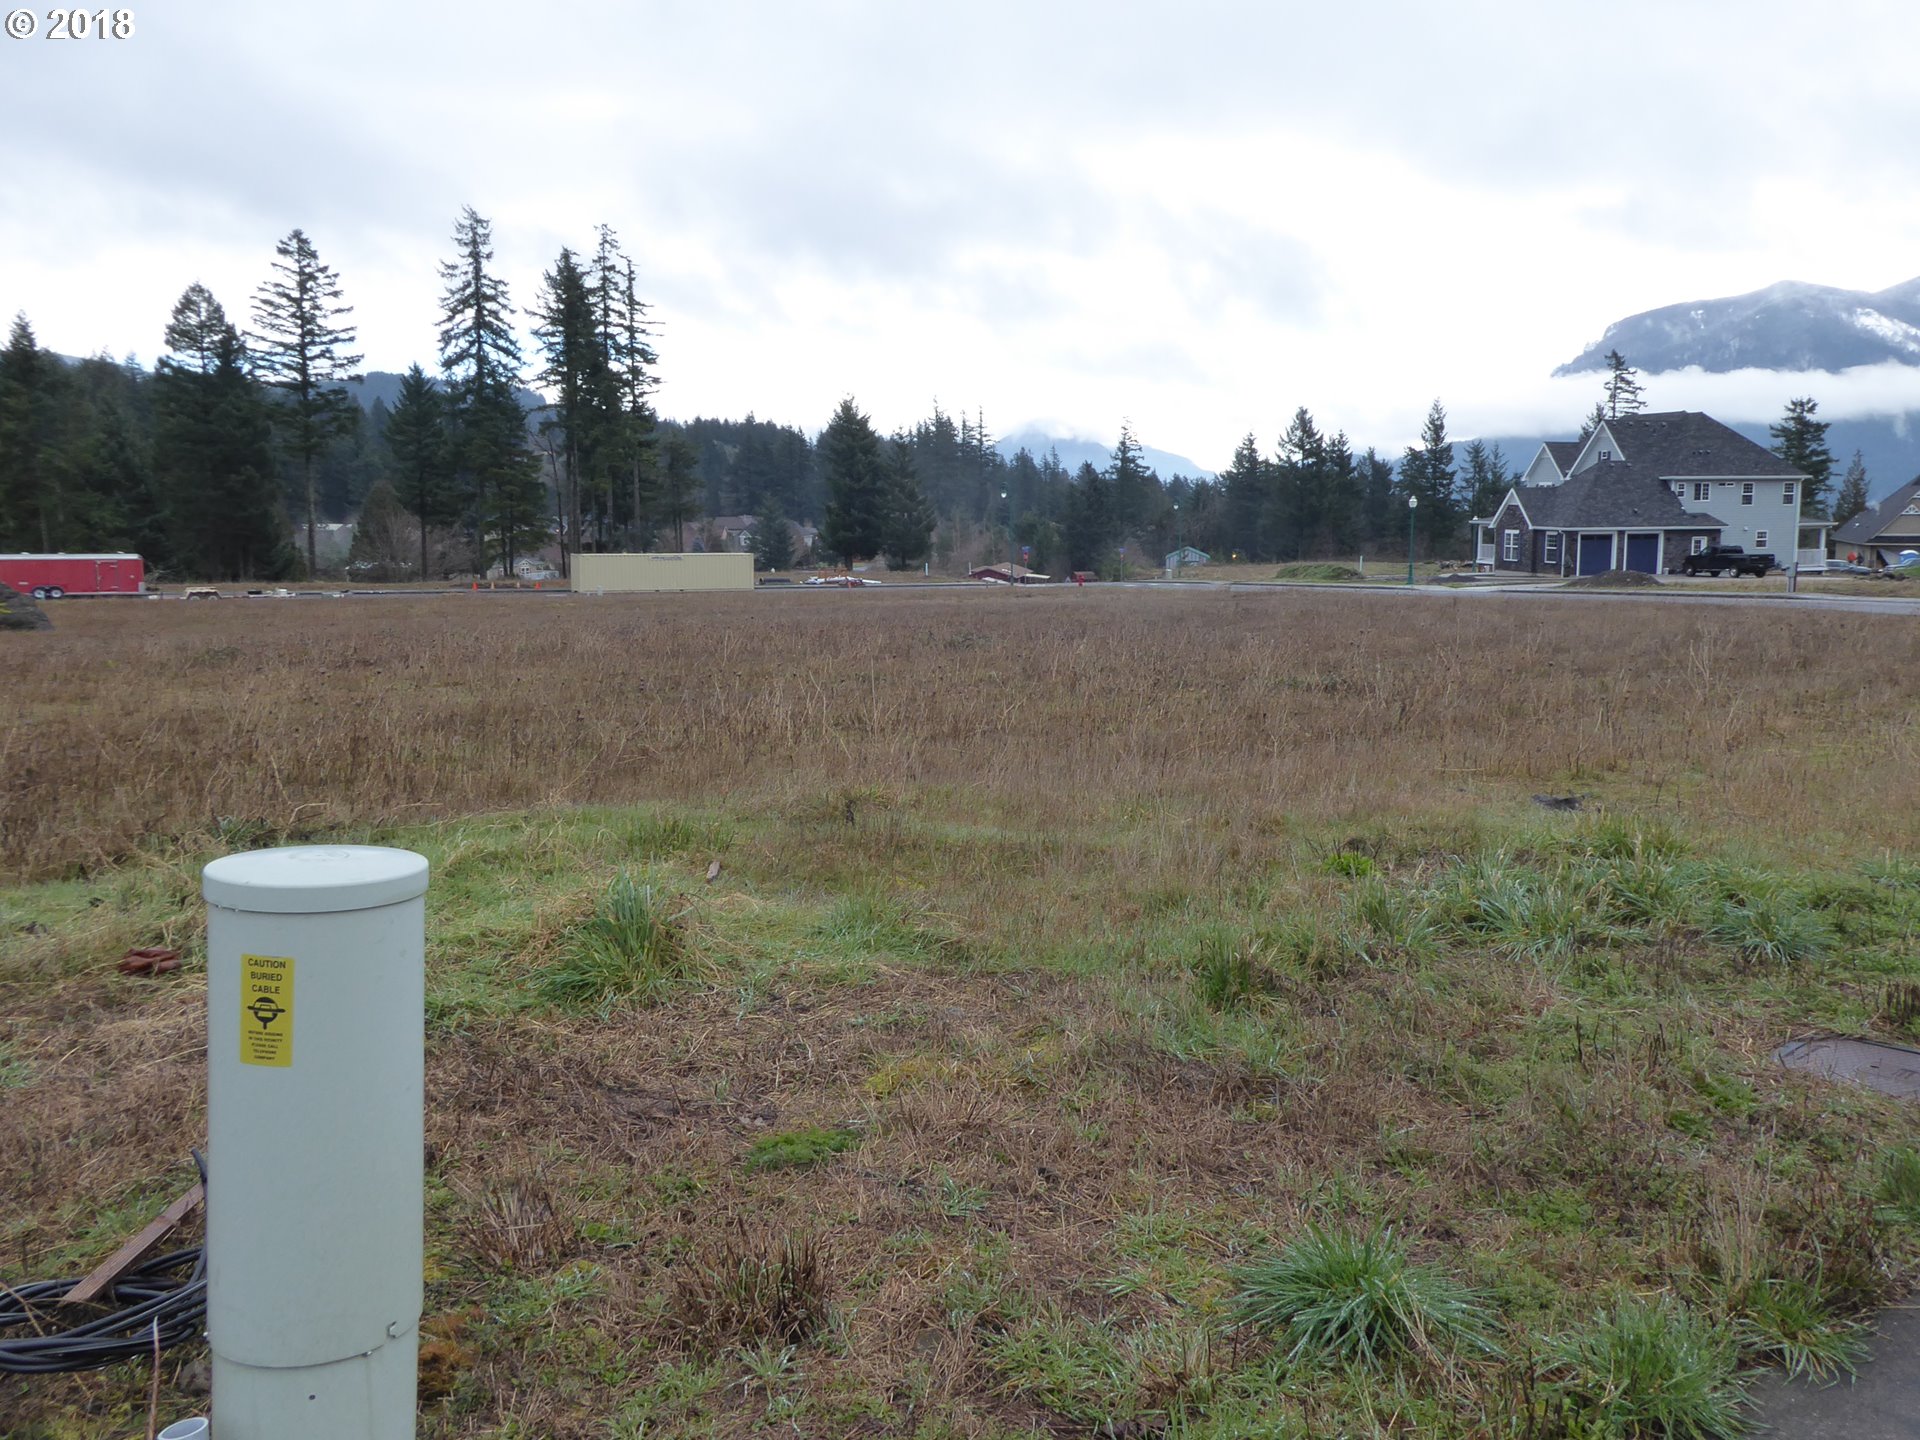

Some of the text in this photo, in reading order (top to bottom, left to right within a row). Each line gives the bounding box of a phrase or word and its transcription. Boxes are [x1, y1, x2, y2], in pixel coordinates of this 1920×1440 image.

[247, 958, 286, 969] CAUTION
[250, 971, 282, 982] BURIED
[252, 984, 280, 995] CABLE
